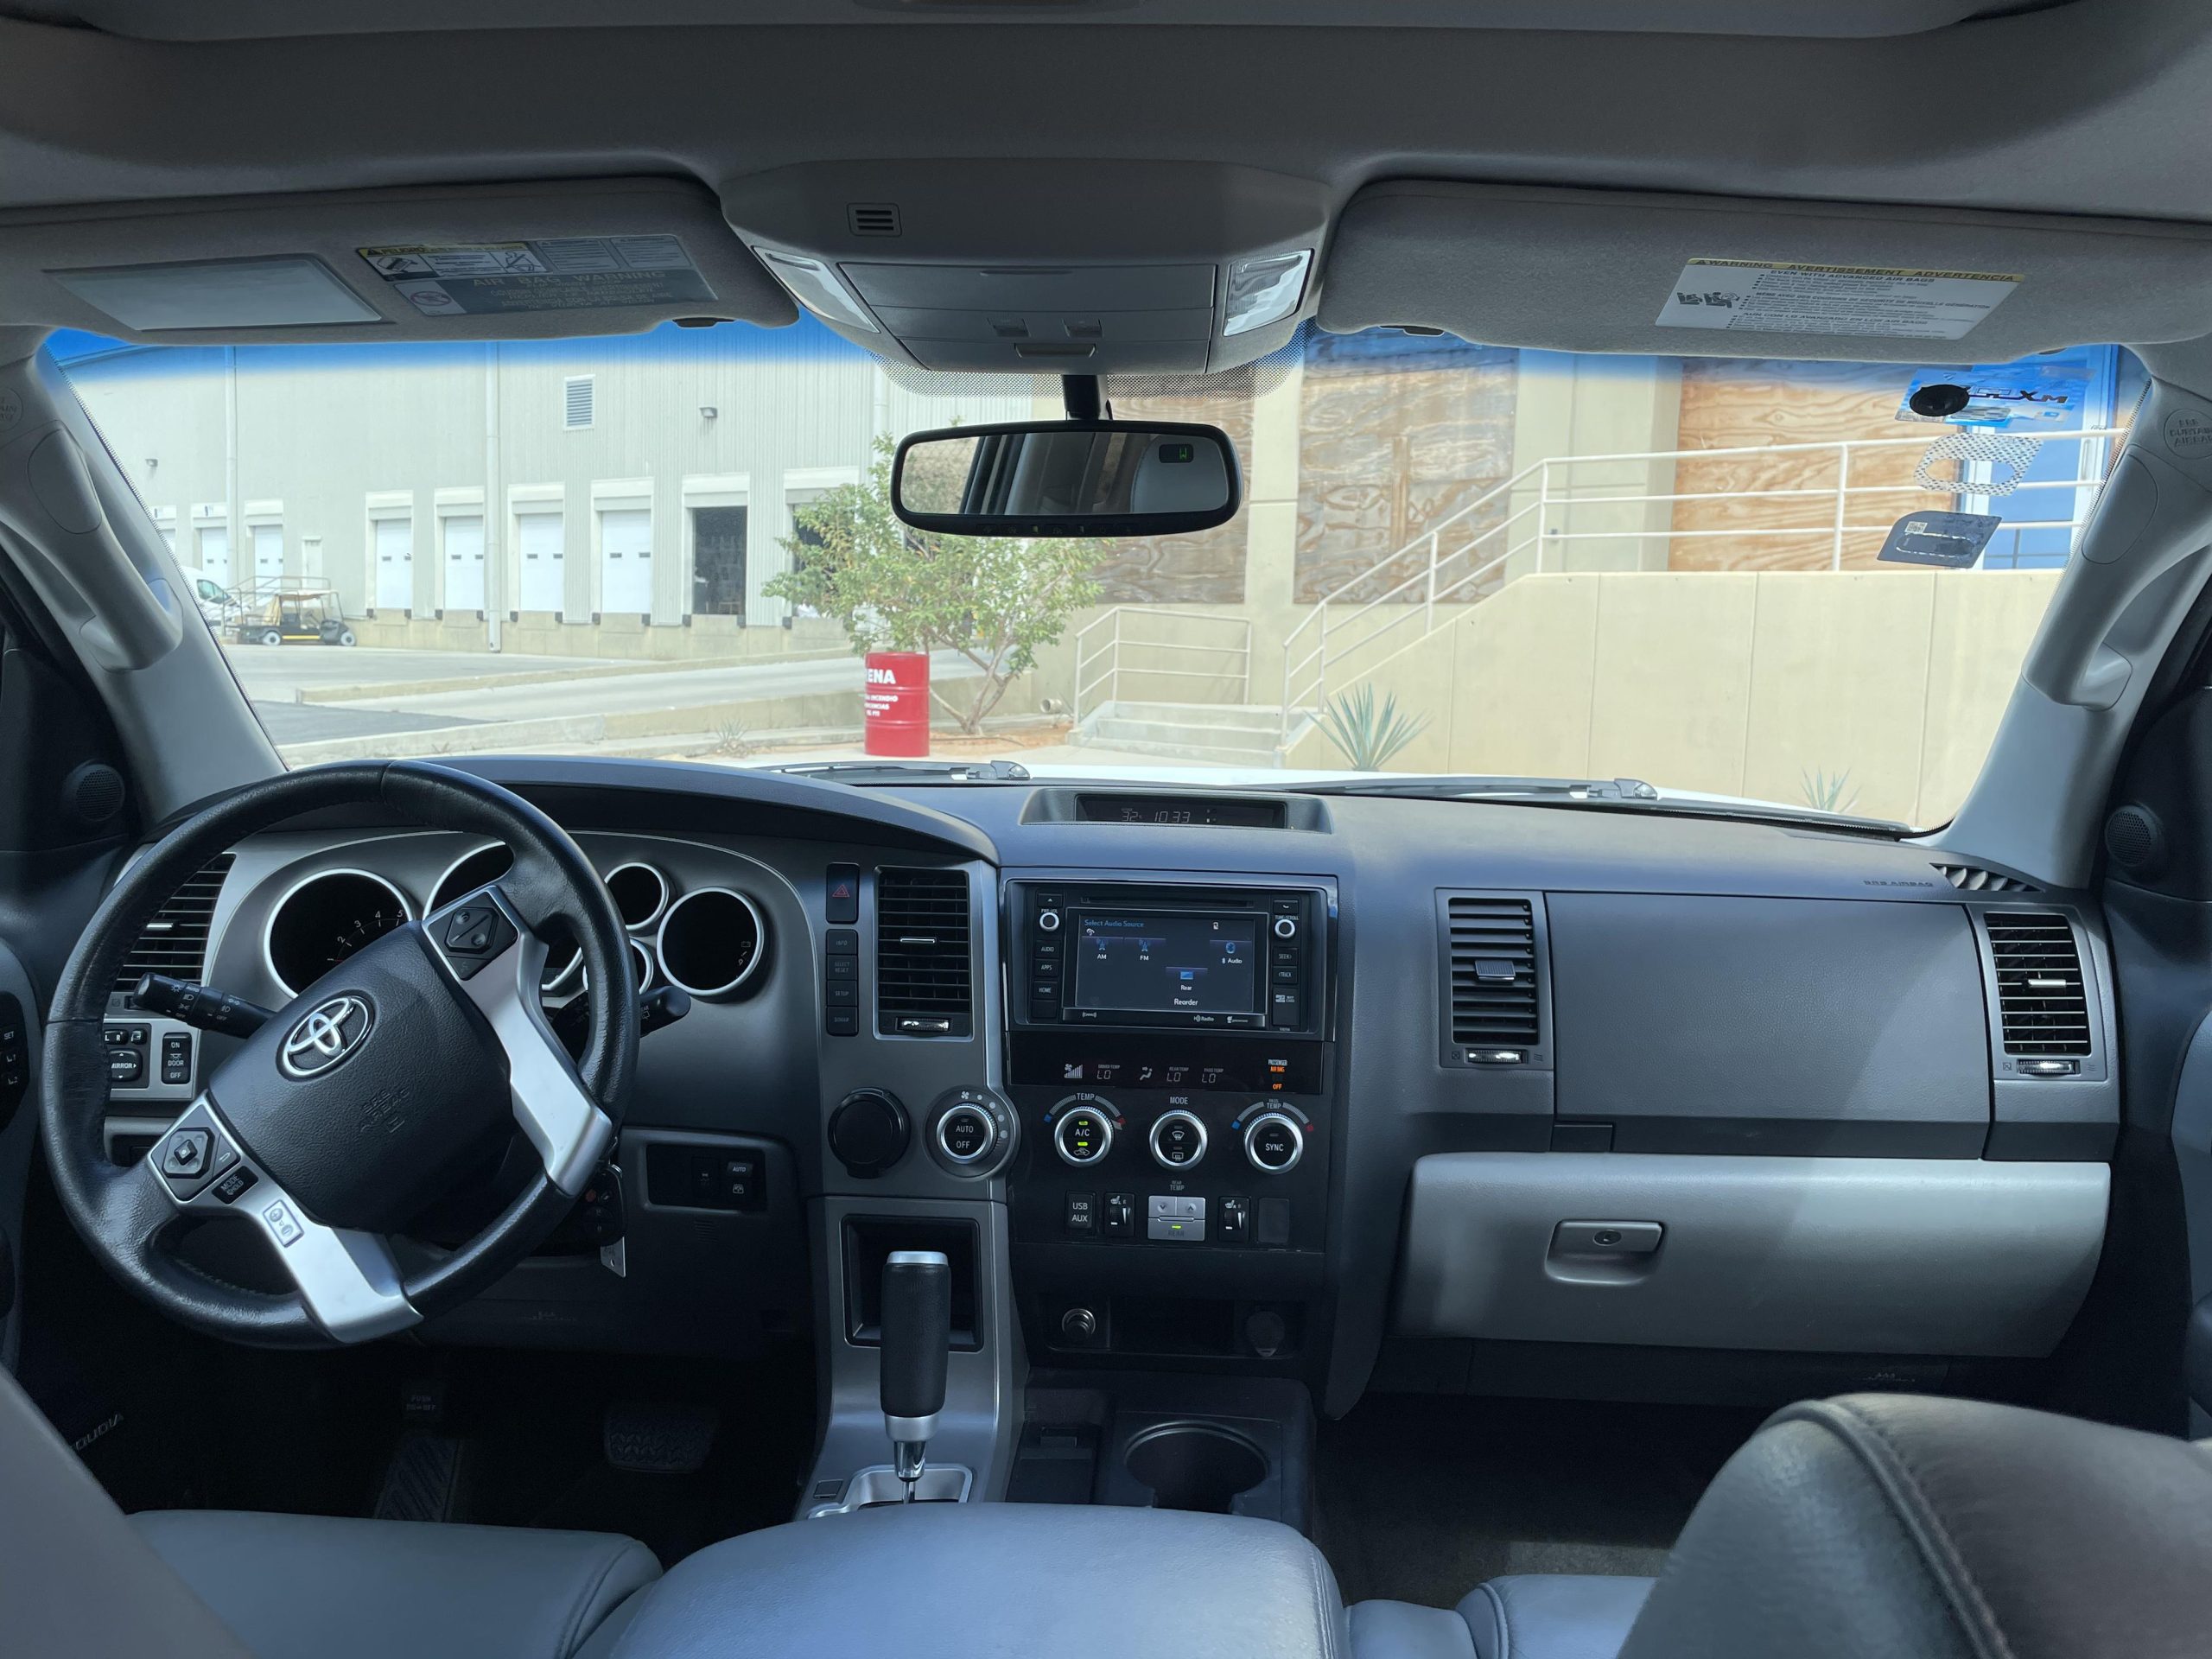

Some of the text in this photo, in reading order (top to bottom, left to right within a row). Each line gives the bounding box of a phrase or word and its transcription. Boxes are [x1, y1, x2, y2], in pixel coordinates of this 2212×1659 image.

[1706, 260, 2013, 282] WARNING AVERTISSEMENT ADVERTENCIA
[473, 270, 666, 286] AIR BAG WARNING
[374, 910, 381, 918] 4
[397, 909, 404, 918] 5
[353, 919, 361, 928] 3
[1077, 1092, 1096, 1101] TEMP
[1169, 1096, 1189, 1104] MODE
[956, 1125, 974, 1134] AUTO
[1074, 1128, 1090, 1138] A/C
[956, 1141, 970, 1149] OFF
[1265, 1142, 1284, 1152] SYNC
[1071, 1214, 1089, 1223] AUX
